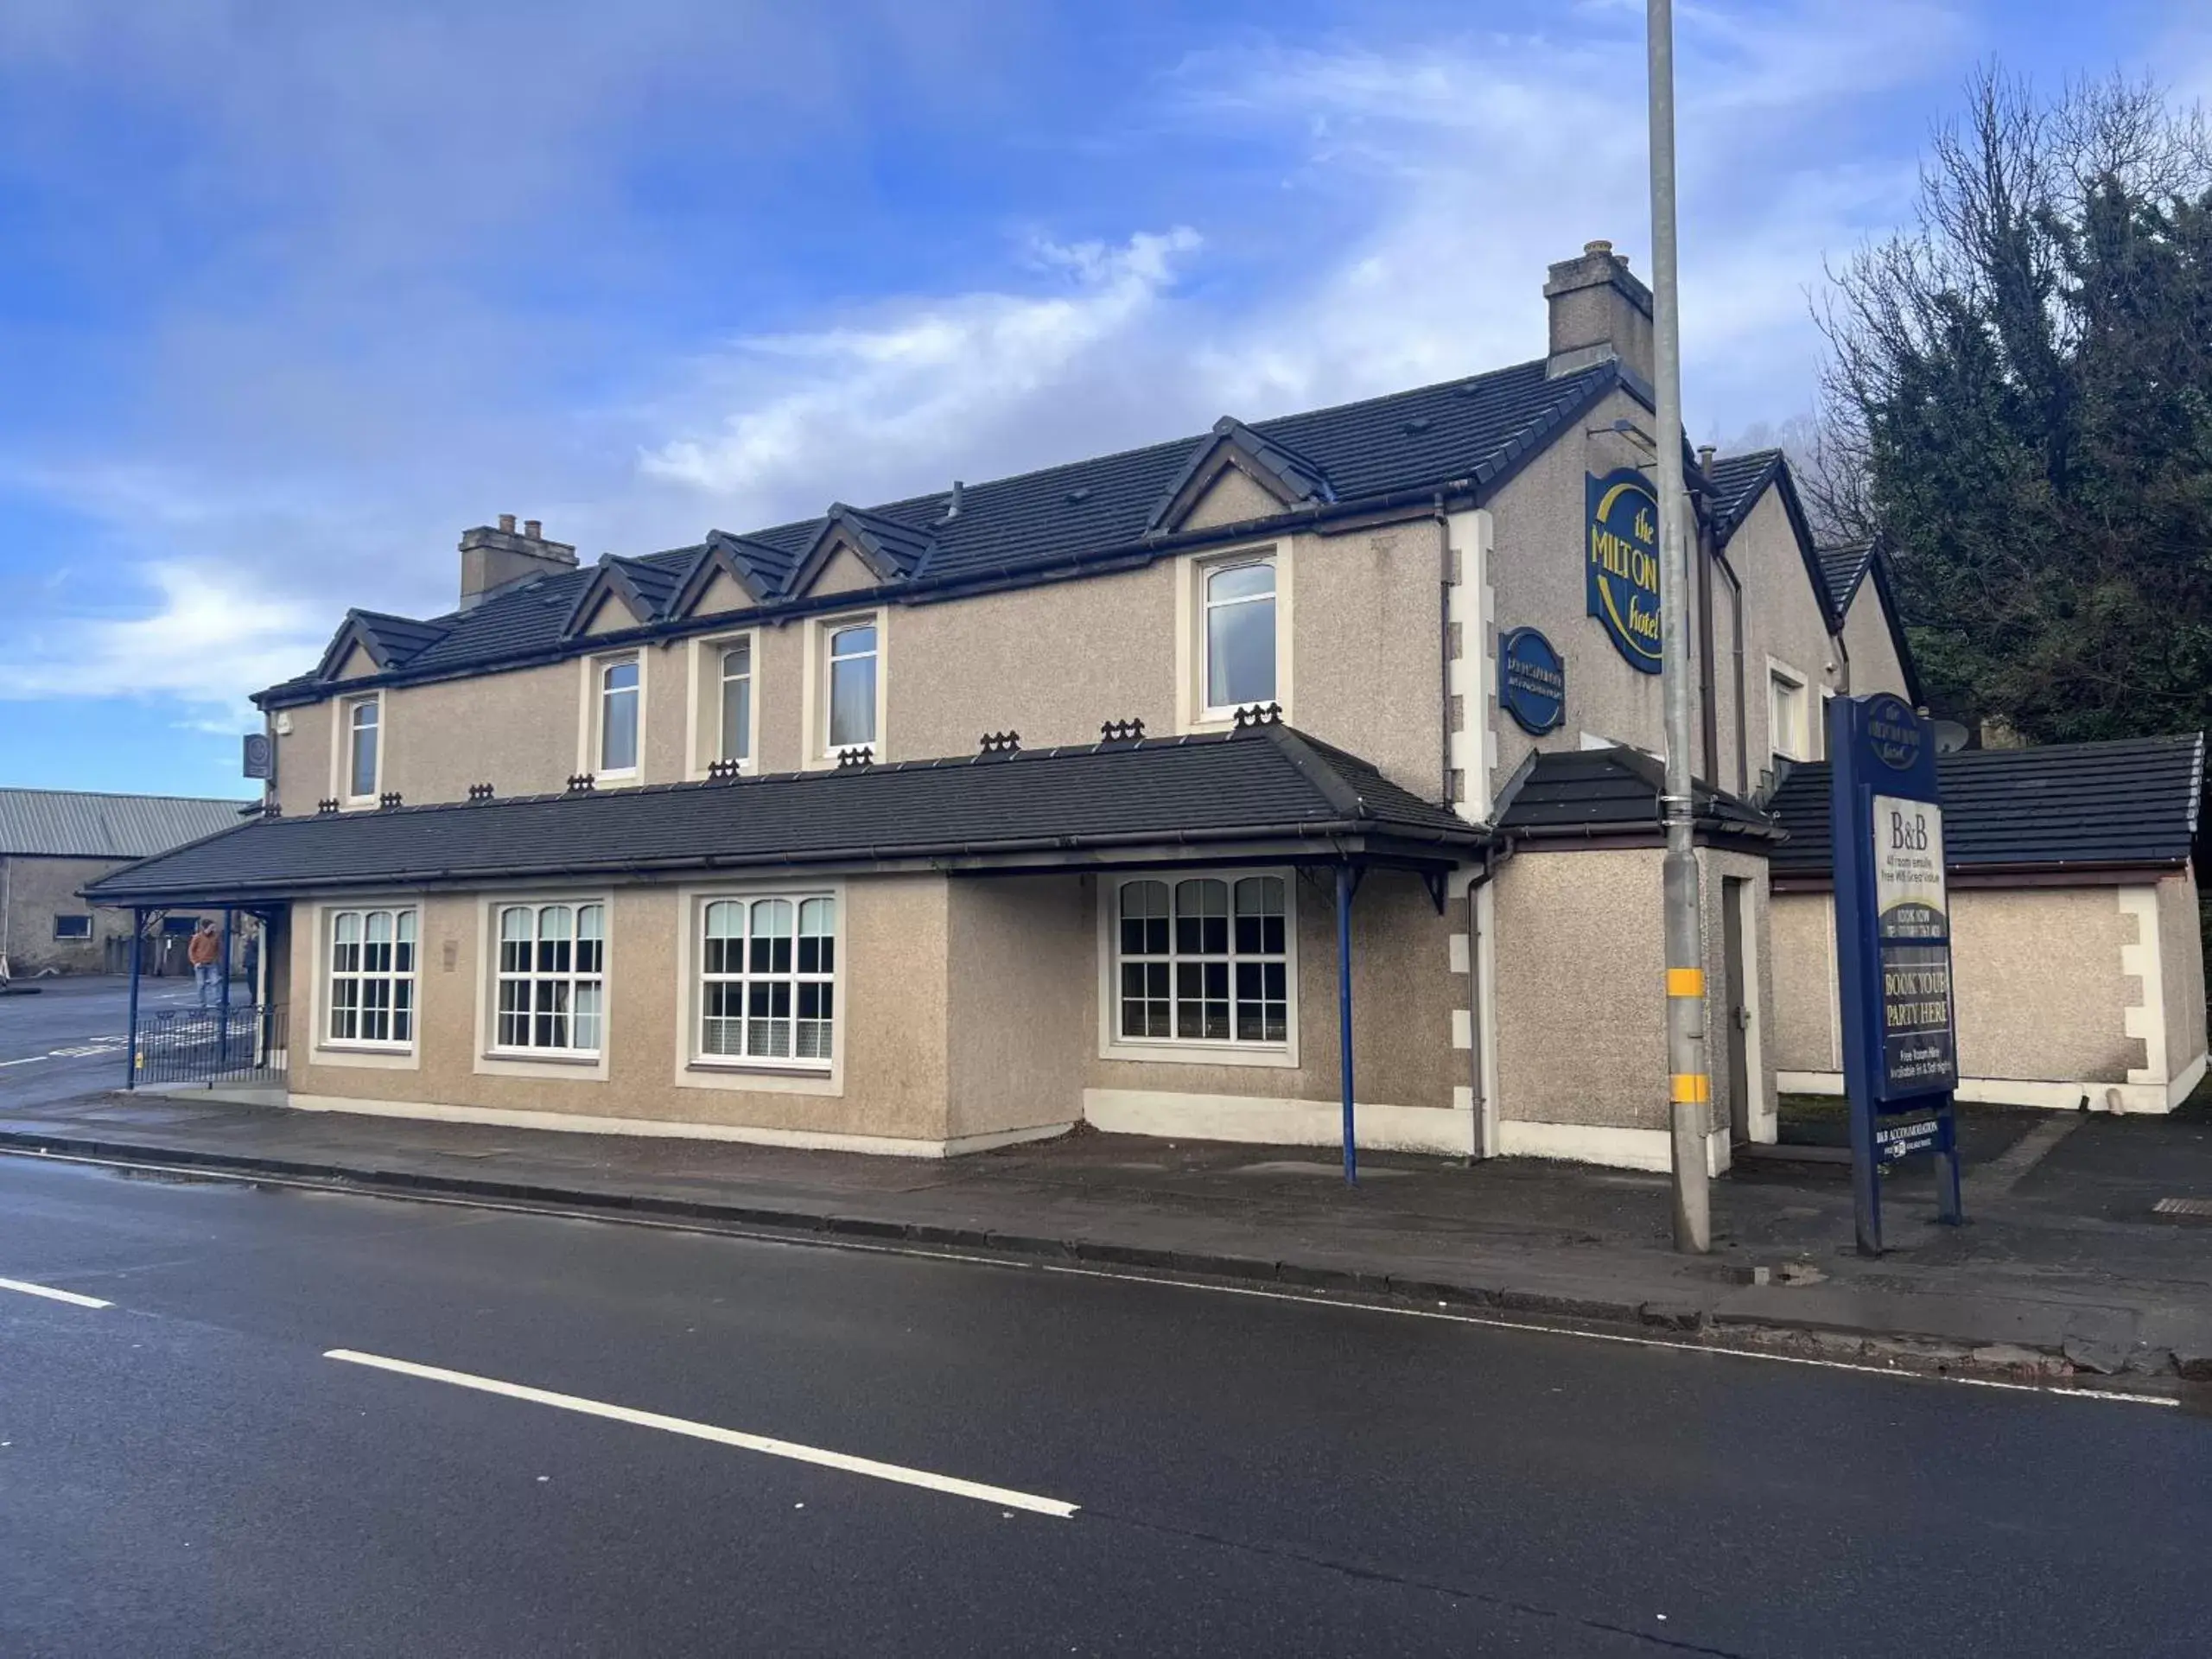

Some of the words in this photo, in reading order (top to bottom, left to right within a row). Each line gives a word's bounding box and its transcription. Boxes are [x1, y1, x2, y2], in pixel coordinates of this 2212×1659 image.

[1635, 507, 1654, 544] the
[1592, 524, 1656, 594] MILTON
[1629, 594, 1661, 640] hotel
[1891, 811, 1928, 850] B&B
[1885, 973, 1916, 995] BOOK
[1917, 972, 1945, 994] YOUR
[1887, 1002, 1920, 1027] PARTY
[1921, 1001, 1947, 1024] HERE
